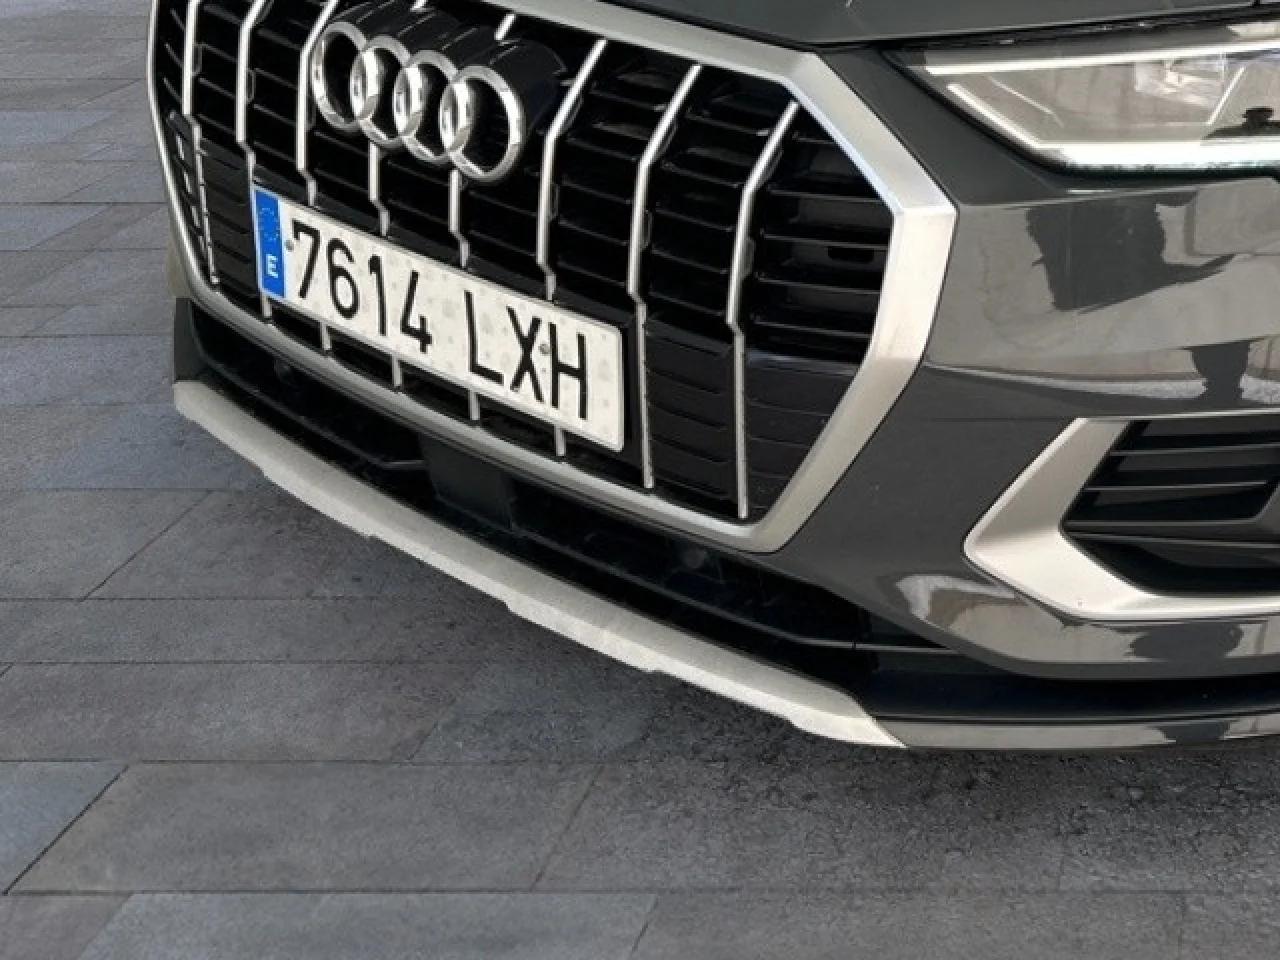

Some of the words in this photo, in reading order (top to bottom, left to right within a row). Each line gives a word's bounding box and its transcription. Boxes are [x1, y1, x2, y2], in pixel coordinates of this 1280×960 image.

[265, 254, 279, 278] E
[291, 219, 433, 353] 7614
[464, 289, 588, 421] LXH
